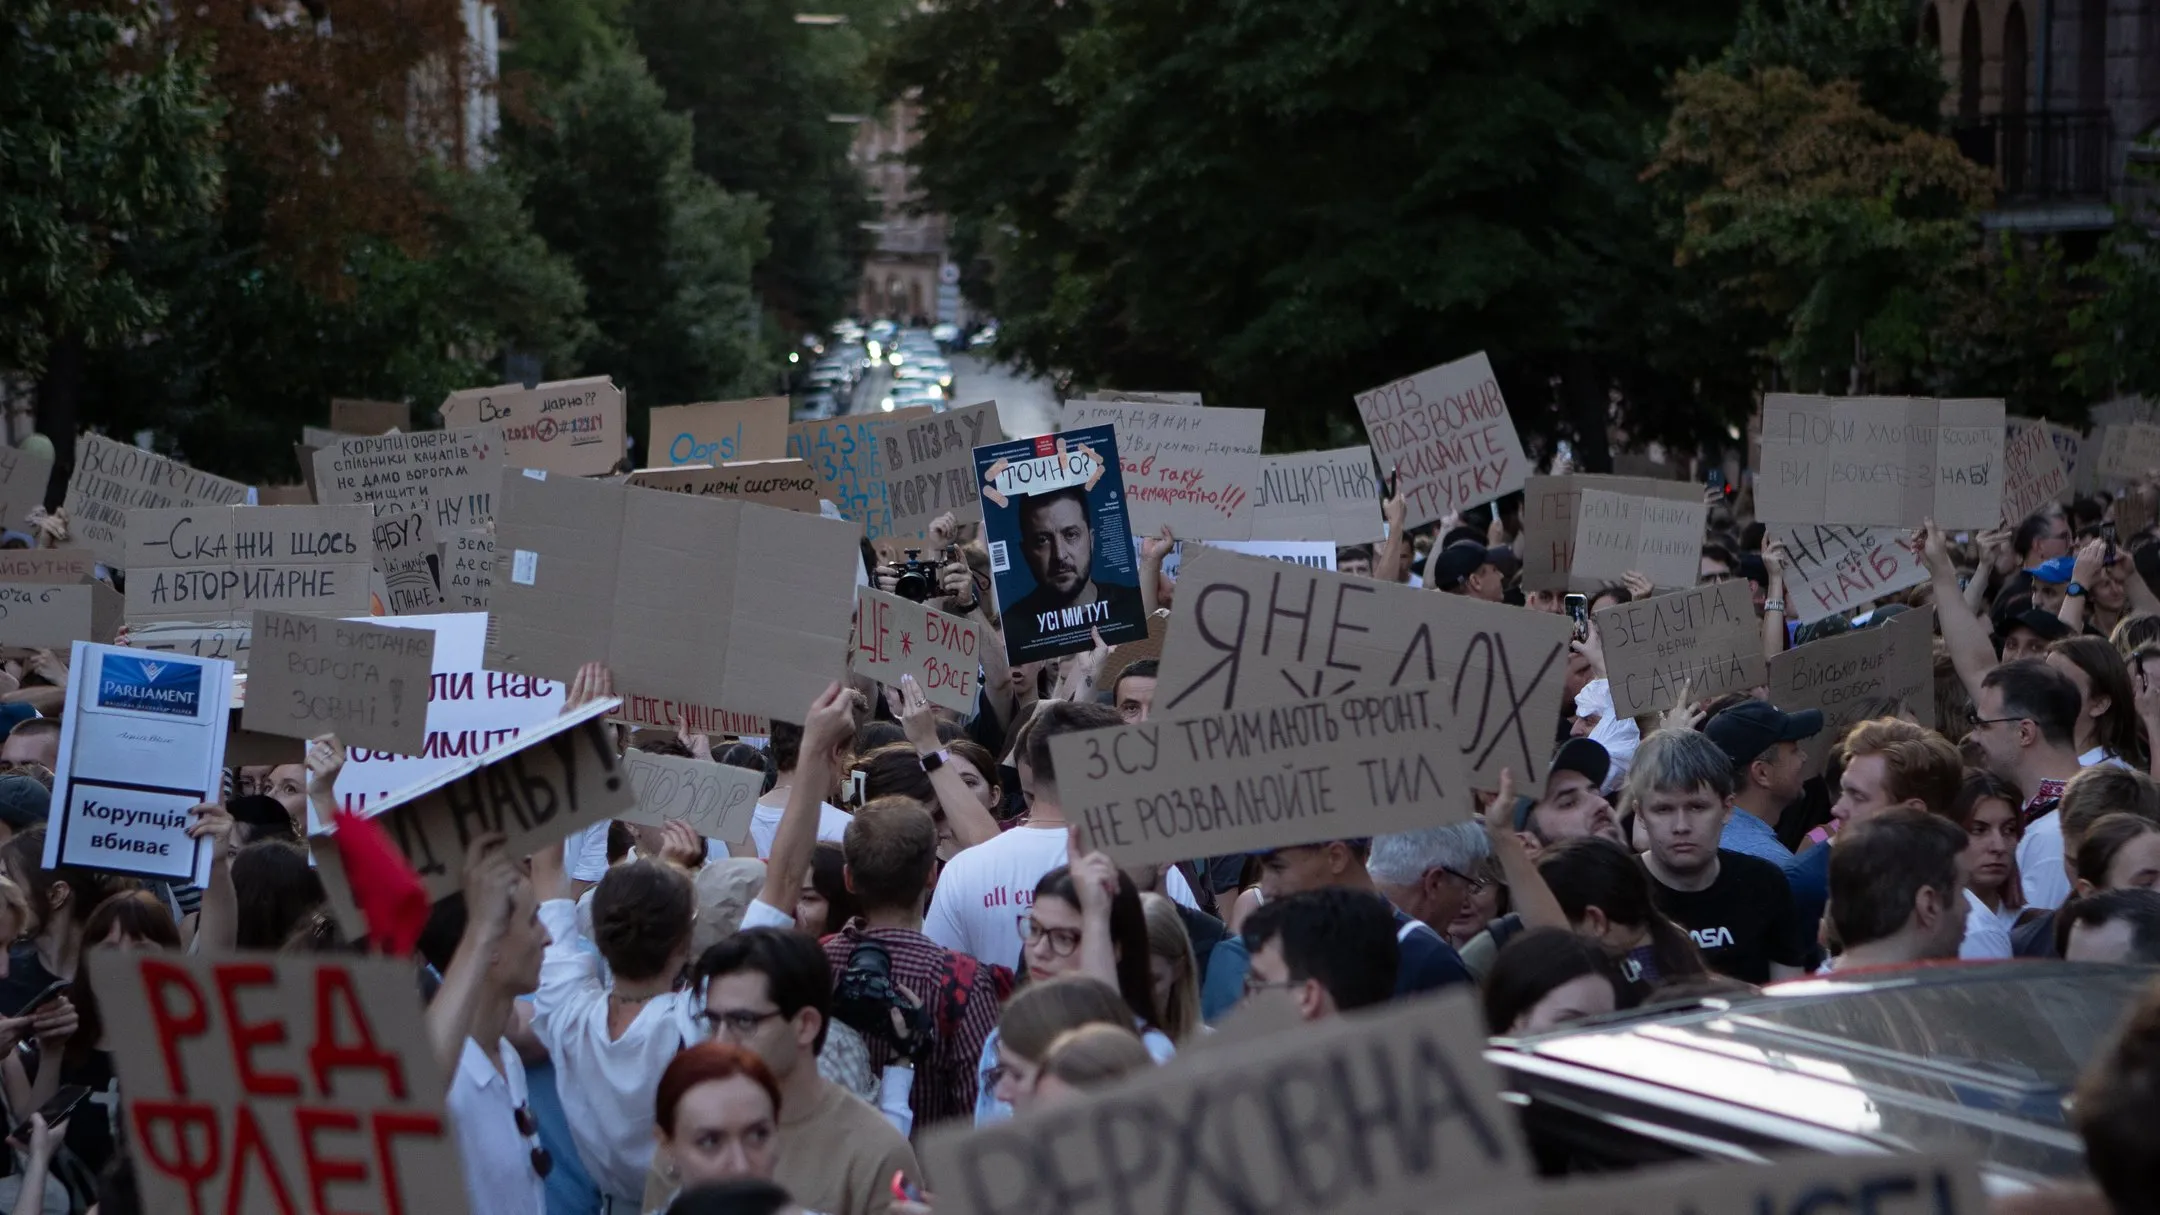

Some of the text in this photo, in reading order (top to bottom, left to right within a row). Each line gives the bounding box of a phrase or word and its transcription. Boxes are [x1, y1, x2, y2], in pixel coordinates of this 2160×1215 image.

[479, 397, 512, 422] Все
[1360, 379, 1422, 425] 2013
[1372, 380, 1503, 455] ПОДЗВОНИВ
[669, 421, 742, 465] Oops!
[1788, 412, 1855, 446] ПОКИ
[886, 436, 904, 471] В
[1001, 452, 1091, 490] ТОЧНО?
[361, 471, 401, 489] ДАМО
[406, 466, 470, 481] ВОРОГАМ
[700, 476, 741, 495] мені
[744, 477, 819, 496] система,
[1159, 467, 1204, 491] таку
[1405, 458, 1508, 518] ТРУБКУ
[1780, 461, 1811, 486] ВИ
[353, 485, 429, 503] ЗНИЩИТИ
[290, 531, 358, 556] ЩОСЬ
[151, 570, 336, 604] АВТОРИТАРНЕ
[859, 598, 890, 663] ЦЕ
[926, 612, 976, 657] БУЛО
[1036, 600, 1110, 634] УСІ МИ ТУТ
[1610, 587, 1741, 648] ЗЕЛУПА,
[264, 615, 431, 658] НАМ ВИСТАЧАЄ
[1657, 635, 1697, 657] ВЕРНИ
[287, 651, 380, 684] ВОРОГА
[923, 656, 970, 697] ВЖЕ
[1165, 571, 1563, 784] Я НЕ ЛОХ
[1625, 652, 1746, 710] САНИЧА
[103, 680, 196, 705] PARLIAMENT
[1085, 688, 1442, 781] ЗСУ ТРИМАЮТЬ ФРОНТ,
[627, 759, 751, 829] ПОЗОР
[1084, 753, 1444, 850] НЕ РОЗВАЛЮЙТЕ ТИЛ
[82, 798, 186, 831] Корупція
[90, 830, 170, 859] вбиває
[983, 884, 1007, 909] all
[140, 960, 406, 1100] РЕД
[132, 1099, 444, 1215] ФЛЕГ
